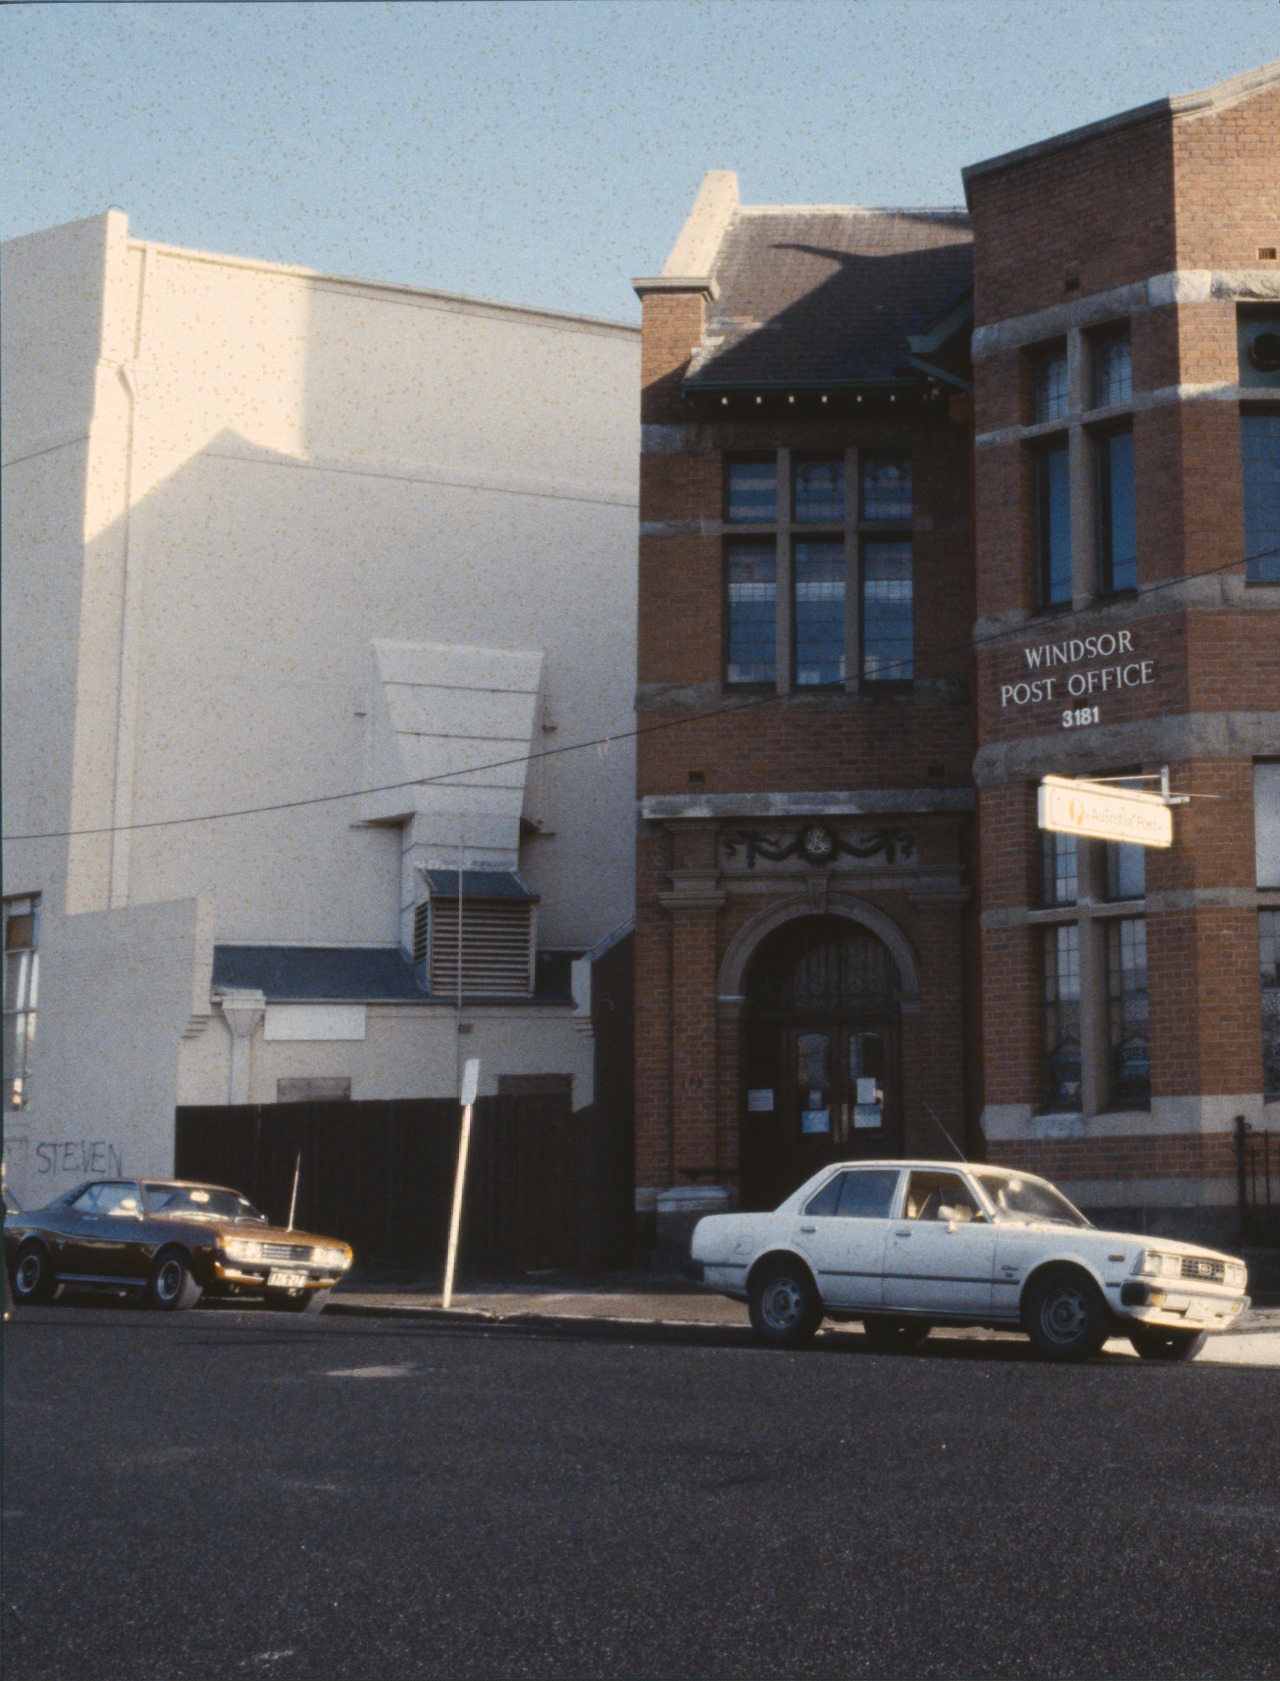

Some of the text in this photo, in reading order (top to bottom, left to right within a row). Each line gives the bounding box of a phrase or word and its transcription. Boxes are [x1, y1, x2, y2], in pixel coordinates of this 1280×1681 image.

[1024, 630, 1135, 669] WINDSOR
[1000, 661, 1156, 707] POST OFFICE
[1061, 706, 1100, 728] 3181
[1091, 807, 1157, 831] Australia Post
[36, 1140, 123, 1177] STEVEN
